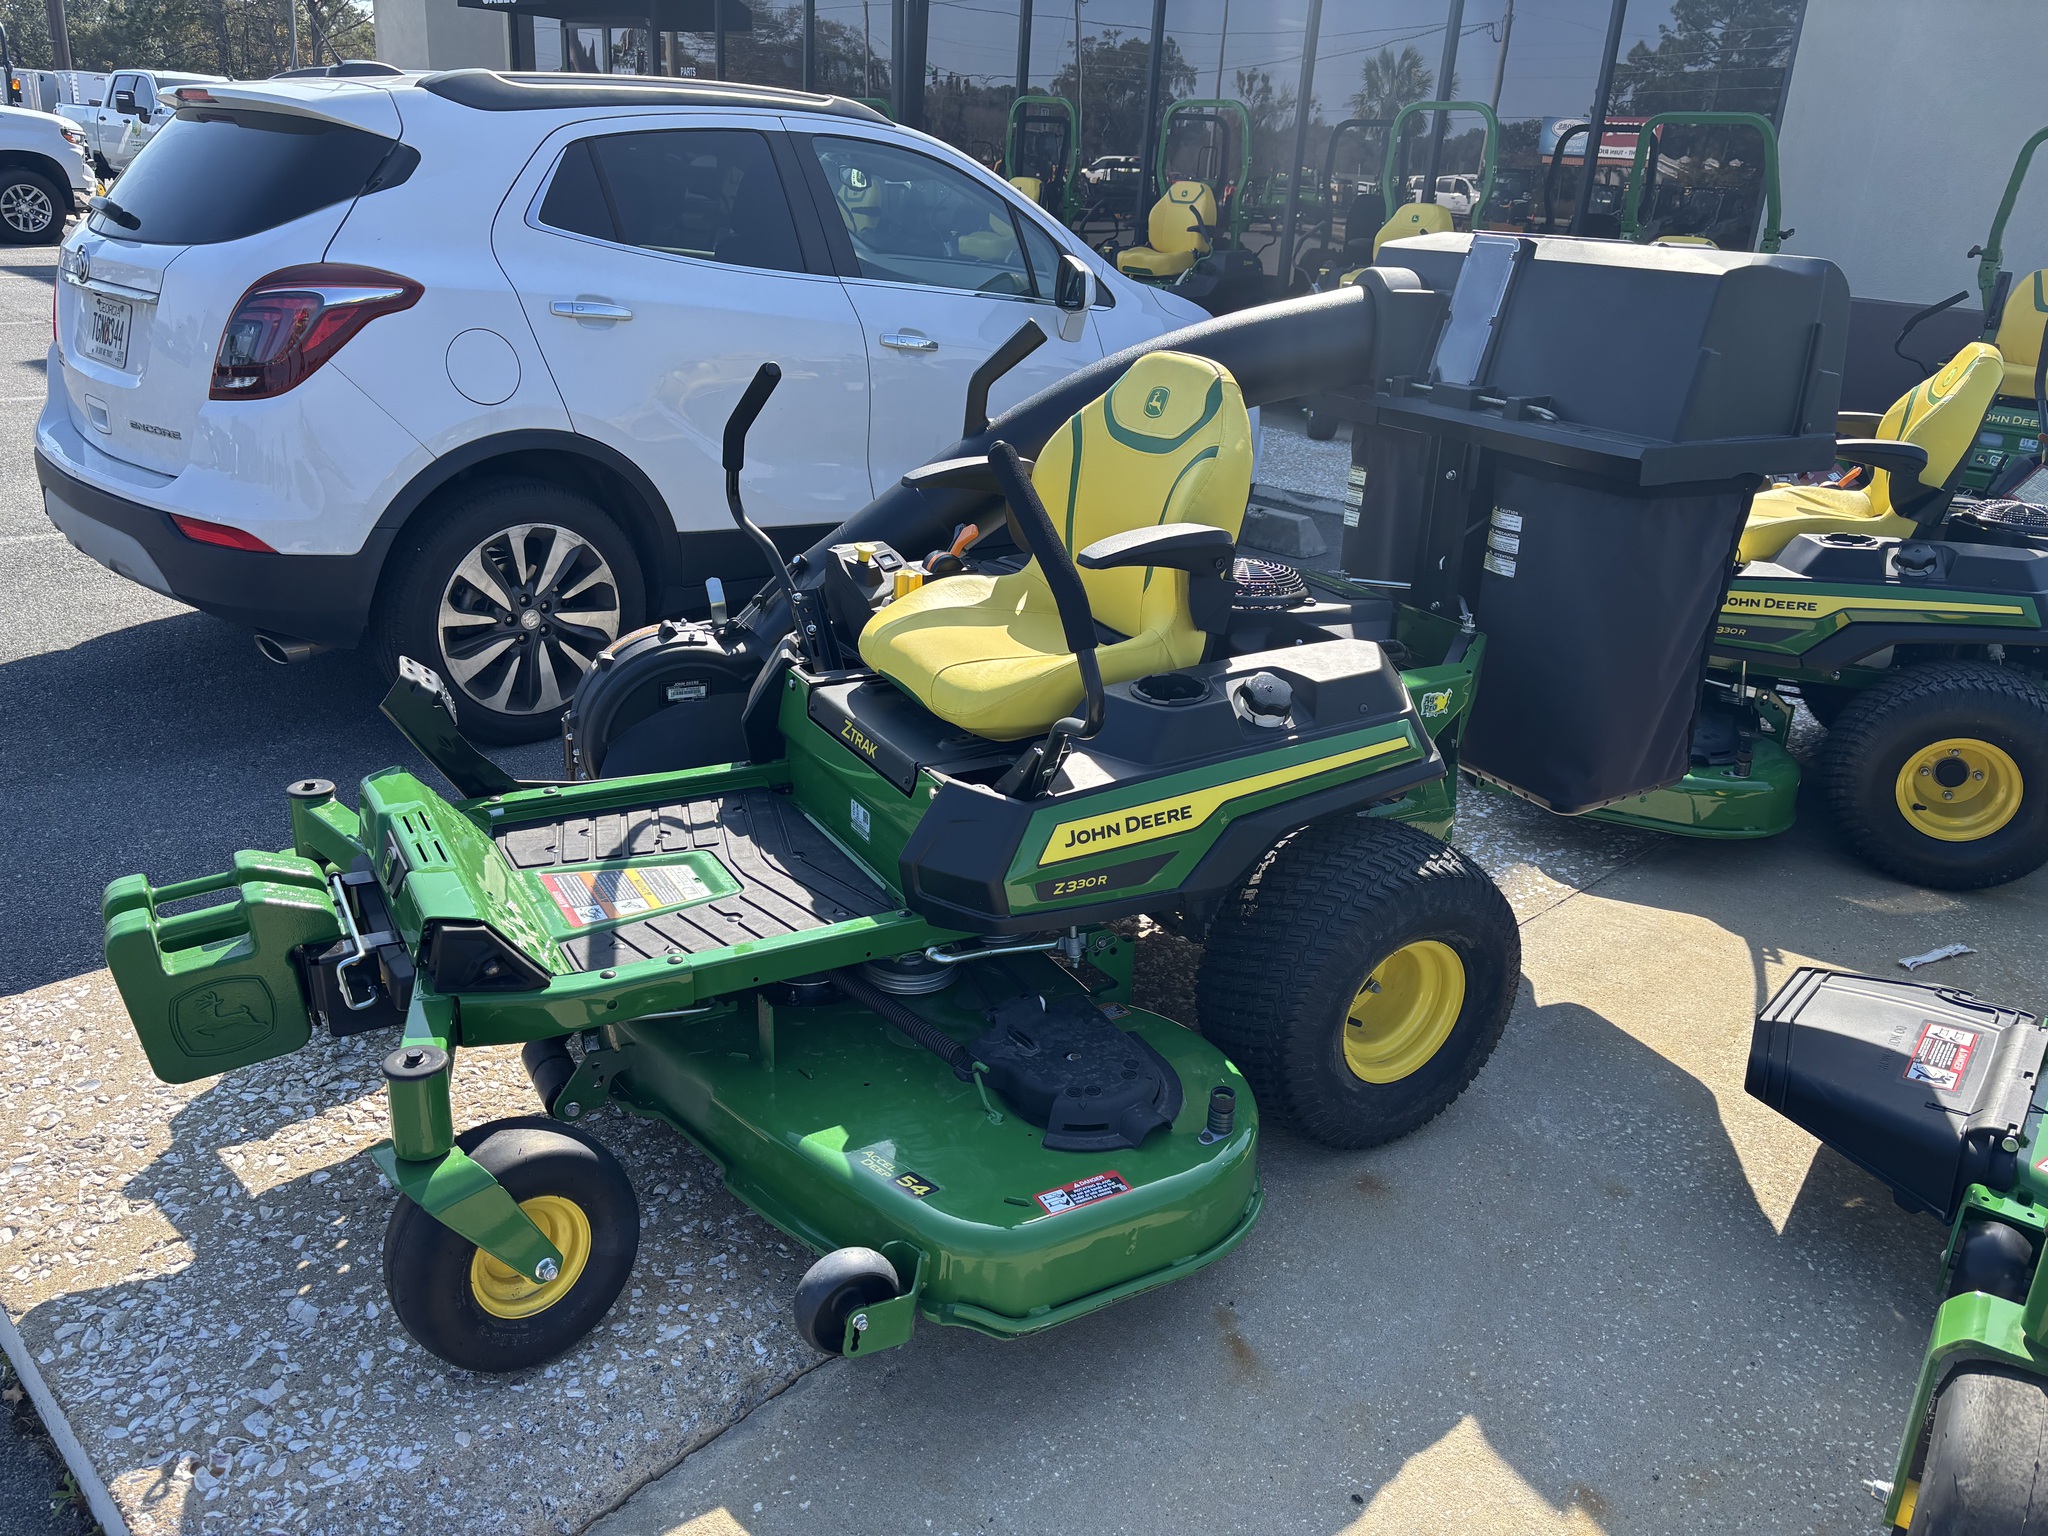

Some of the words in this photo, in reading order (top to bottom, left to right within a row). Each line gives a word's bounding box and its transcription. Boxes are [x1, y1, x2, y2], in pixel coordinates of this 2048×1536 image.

[680, 66, 697, 77] PARTS
[130, 420, 182, 440] ENCORE
[2012, 415, 2040, 428] DEE
[1764, 597, 1818, 612] DEERE
[1716, 626, 1747, 636] 330R
[841, 719, 878, 760] ZTRAK
[1065, 822, 1121, 848] JOHN
[1125, 805, 1193, 834] DEERE
[860, 1159, 892, 1178] DEEP
[861, 1150, 896, 1172] ACCEL
[896, 1175, 931, 1195] 54
[1079, 1175, 1105, 1186] DANGER
